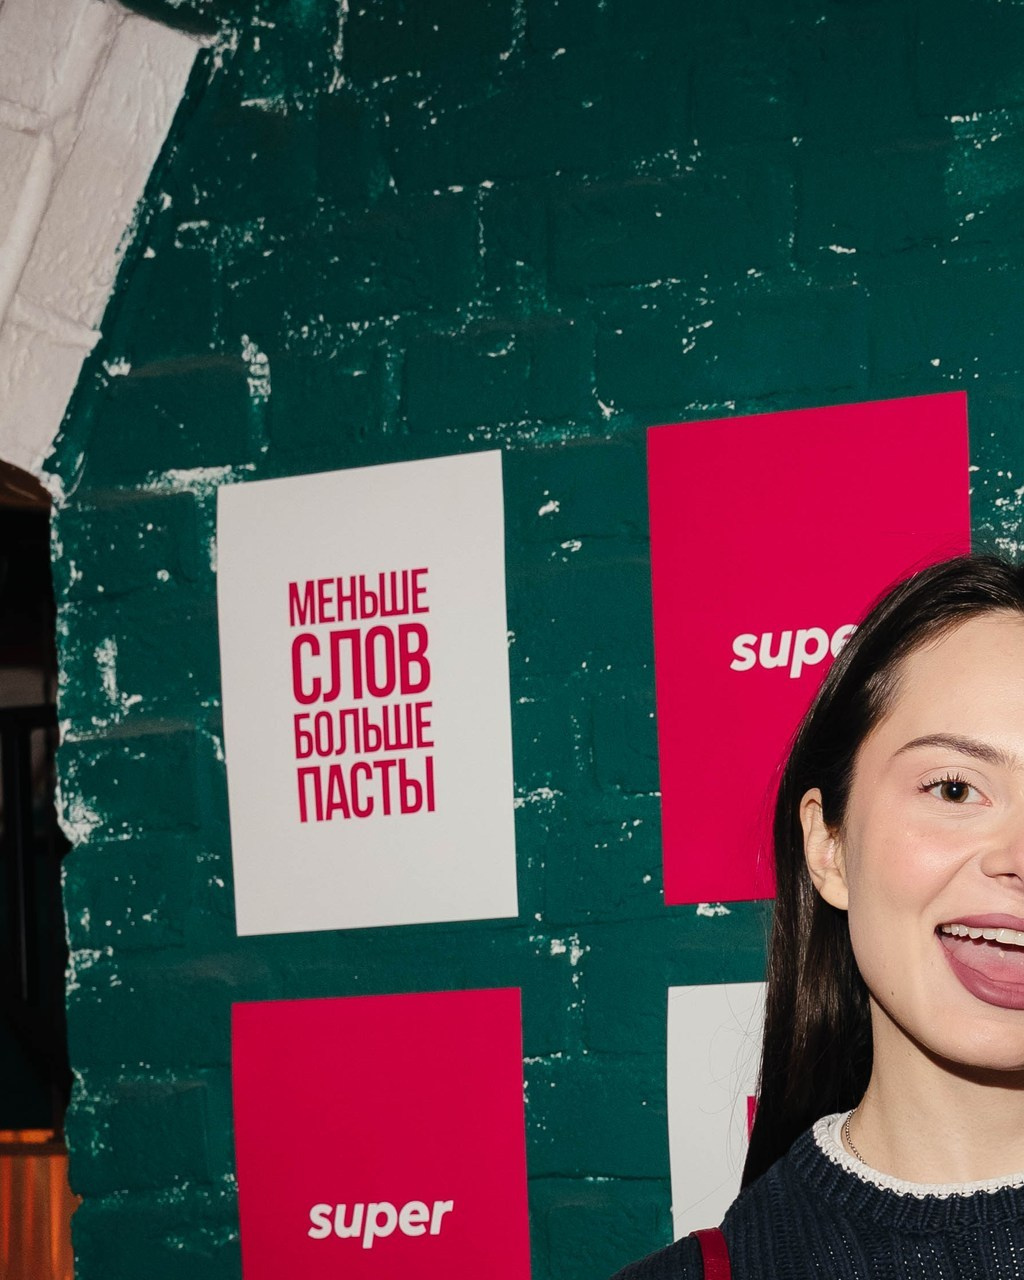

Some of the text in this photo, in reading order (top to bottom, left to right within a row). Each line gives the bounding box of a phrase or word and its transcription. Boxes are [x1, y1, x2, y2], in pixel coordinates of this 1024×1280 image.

[287, 566, 431, 627] МЕНЬШЕ
[290, 621, 432, 707] СЛОВ
[292, 700, 435, 760] БОЛЬШЕ
[296, 754, 437, 824] ПАСТЫ
[307, 1199, 454, 1249] super
